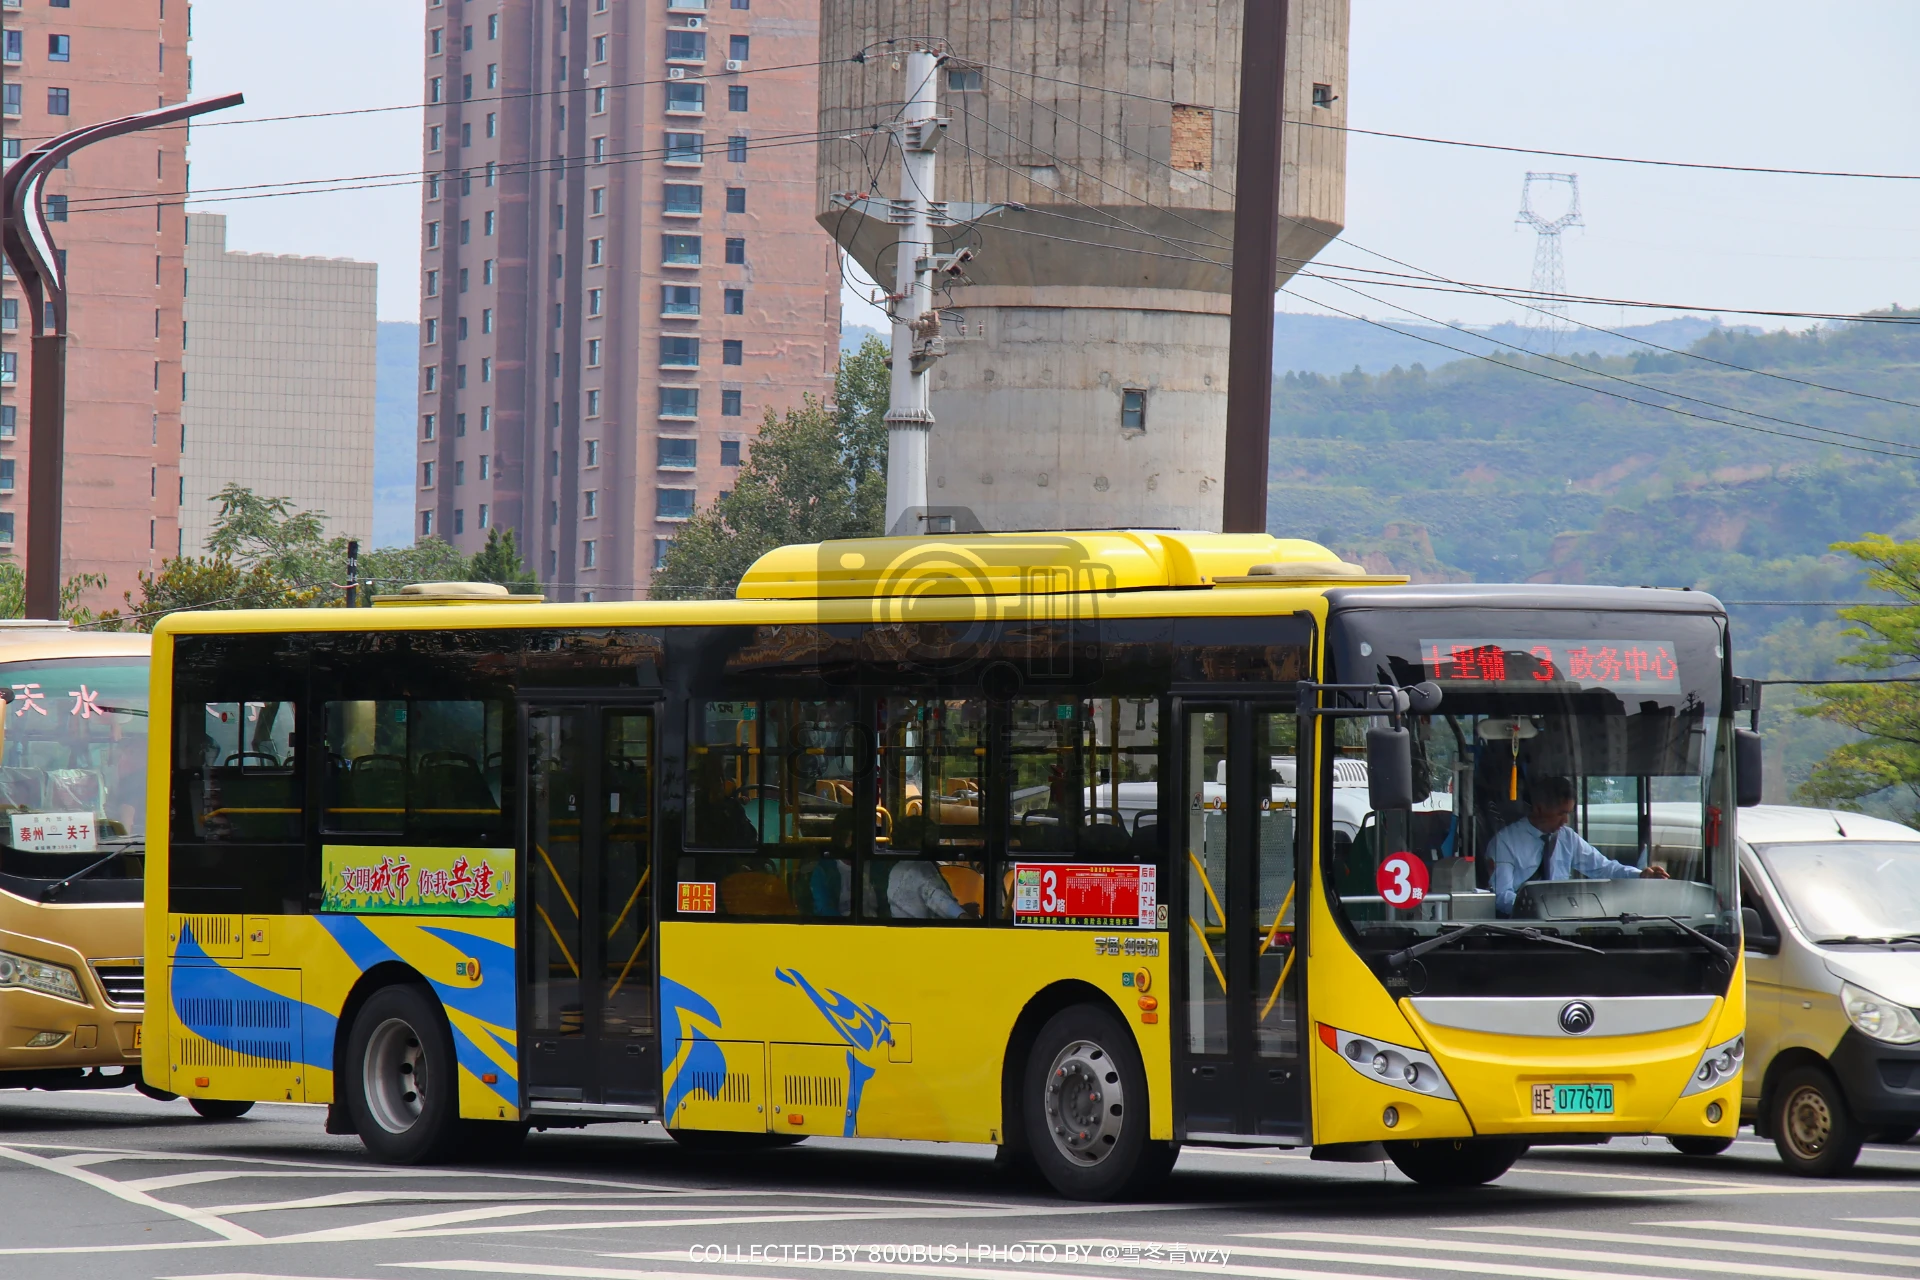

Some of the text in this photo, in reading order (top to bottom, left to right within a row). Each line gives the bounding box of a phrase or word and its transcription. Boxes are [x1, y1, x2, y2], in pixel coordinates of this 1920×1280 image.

[1422, 645, 1678, 682] 十里铺 3 政务中心
[341, 854, 496, 903] 文明城市 你我共建
[681, 884, 712, 897] 前门上
[681, 898, 712, 911] 后门下
